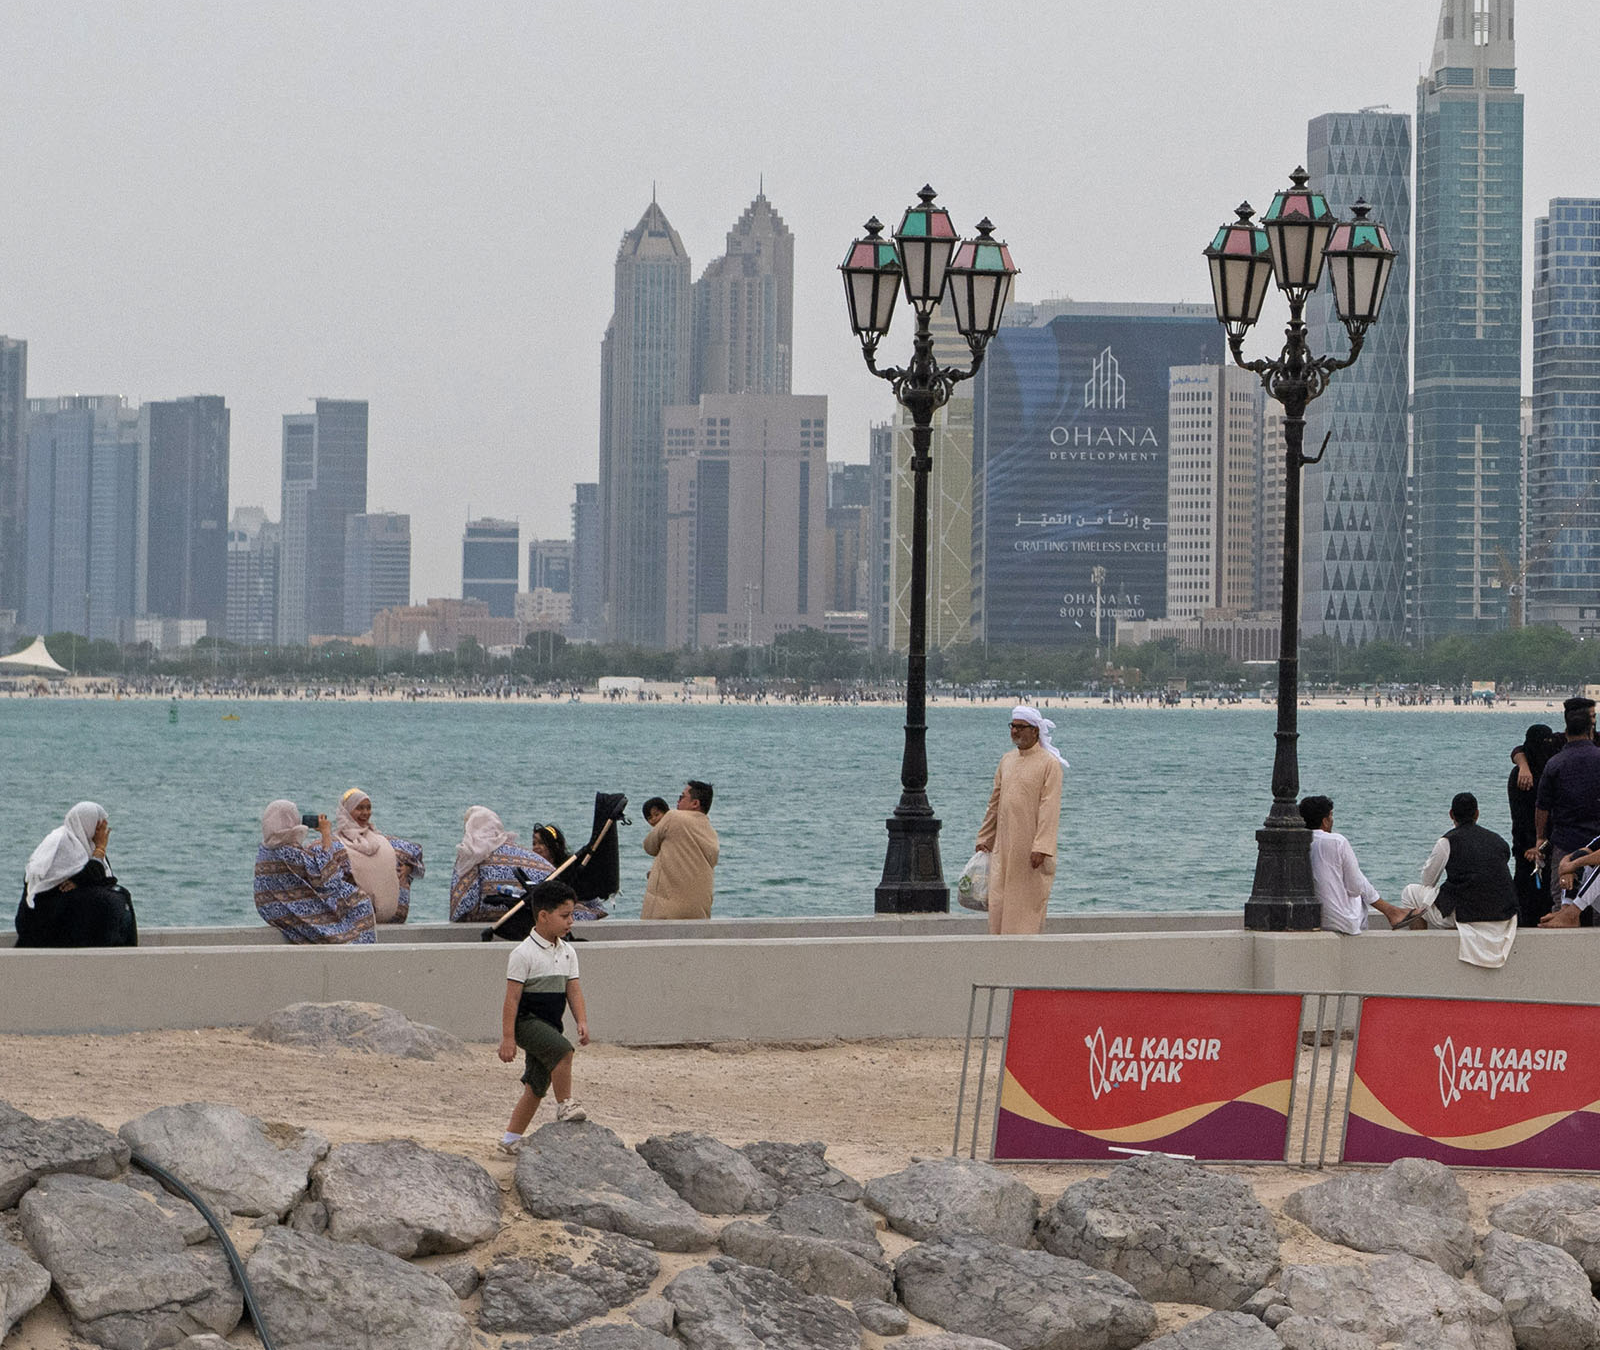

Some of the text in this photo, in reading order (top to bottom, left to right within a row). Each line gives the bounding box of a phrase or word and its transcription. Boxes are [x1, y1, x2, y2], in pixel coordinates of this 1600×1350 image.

[1050, 426, 1159, 447] OHANA
[1050, 452, 1158, 461] DEVELOPMENT
[1014, 541, 1167, 552] CRAFTING TIMELESS EXCELLE
[1059, 607, 1084, 617] 800
[1109, 1037, 1221, 1060] AL KAASIR
[1458, 1047, 1568, 1071] AL KAASIR
[1110, 1060, 1183, 1090] KAYAK
[1459, 1069, 1532, 1099] KAYAK
